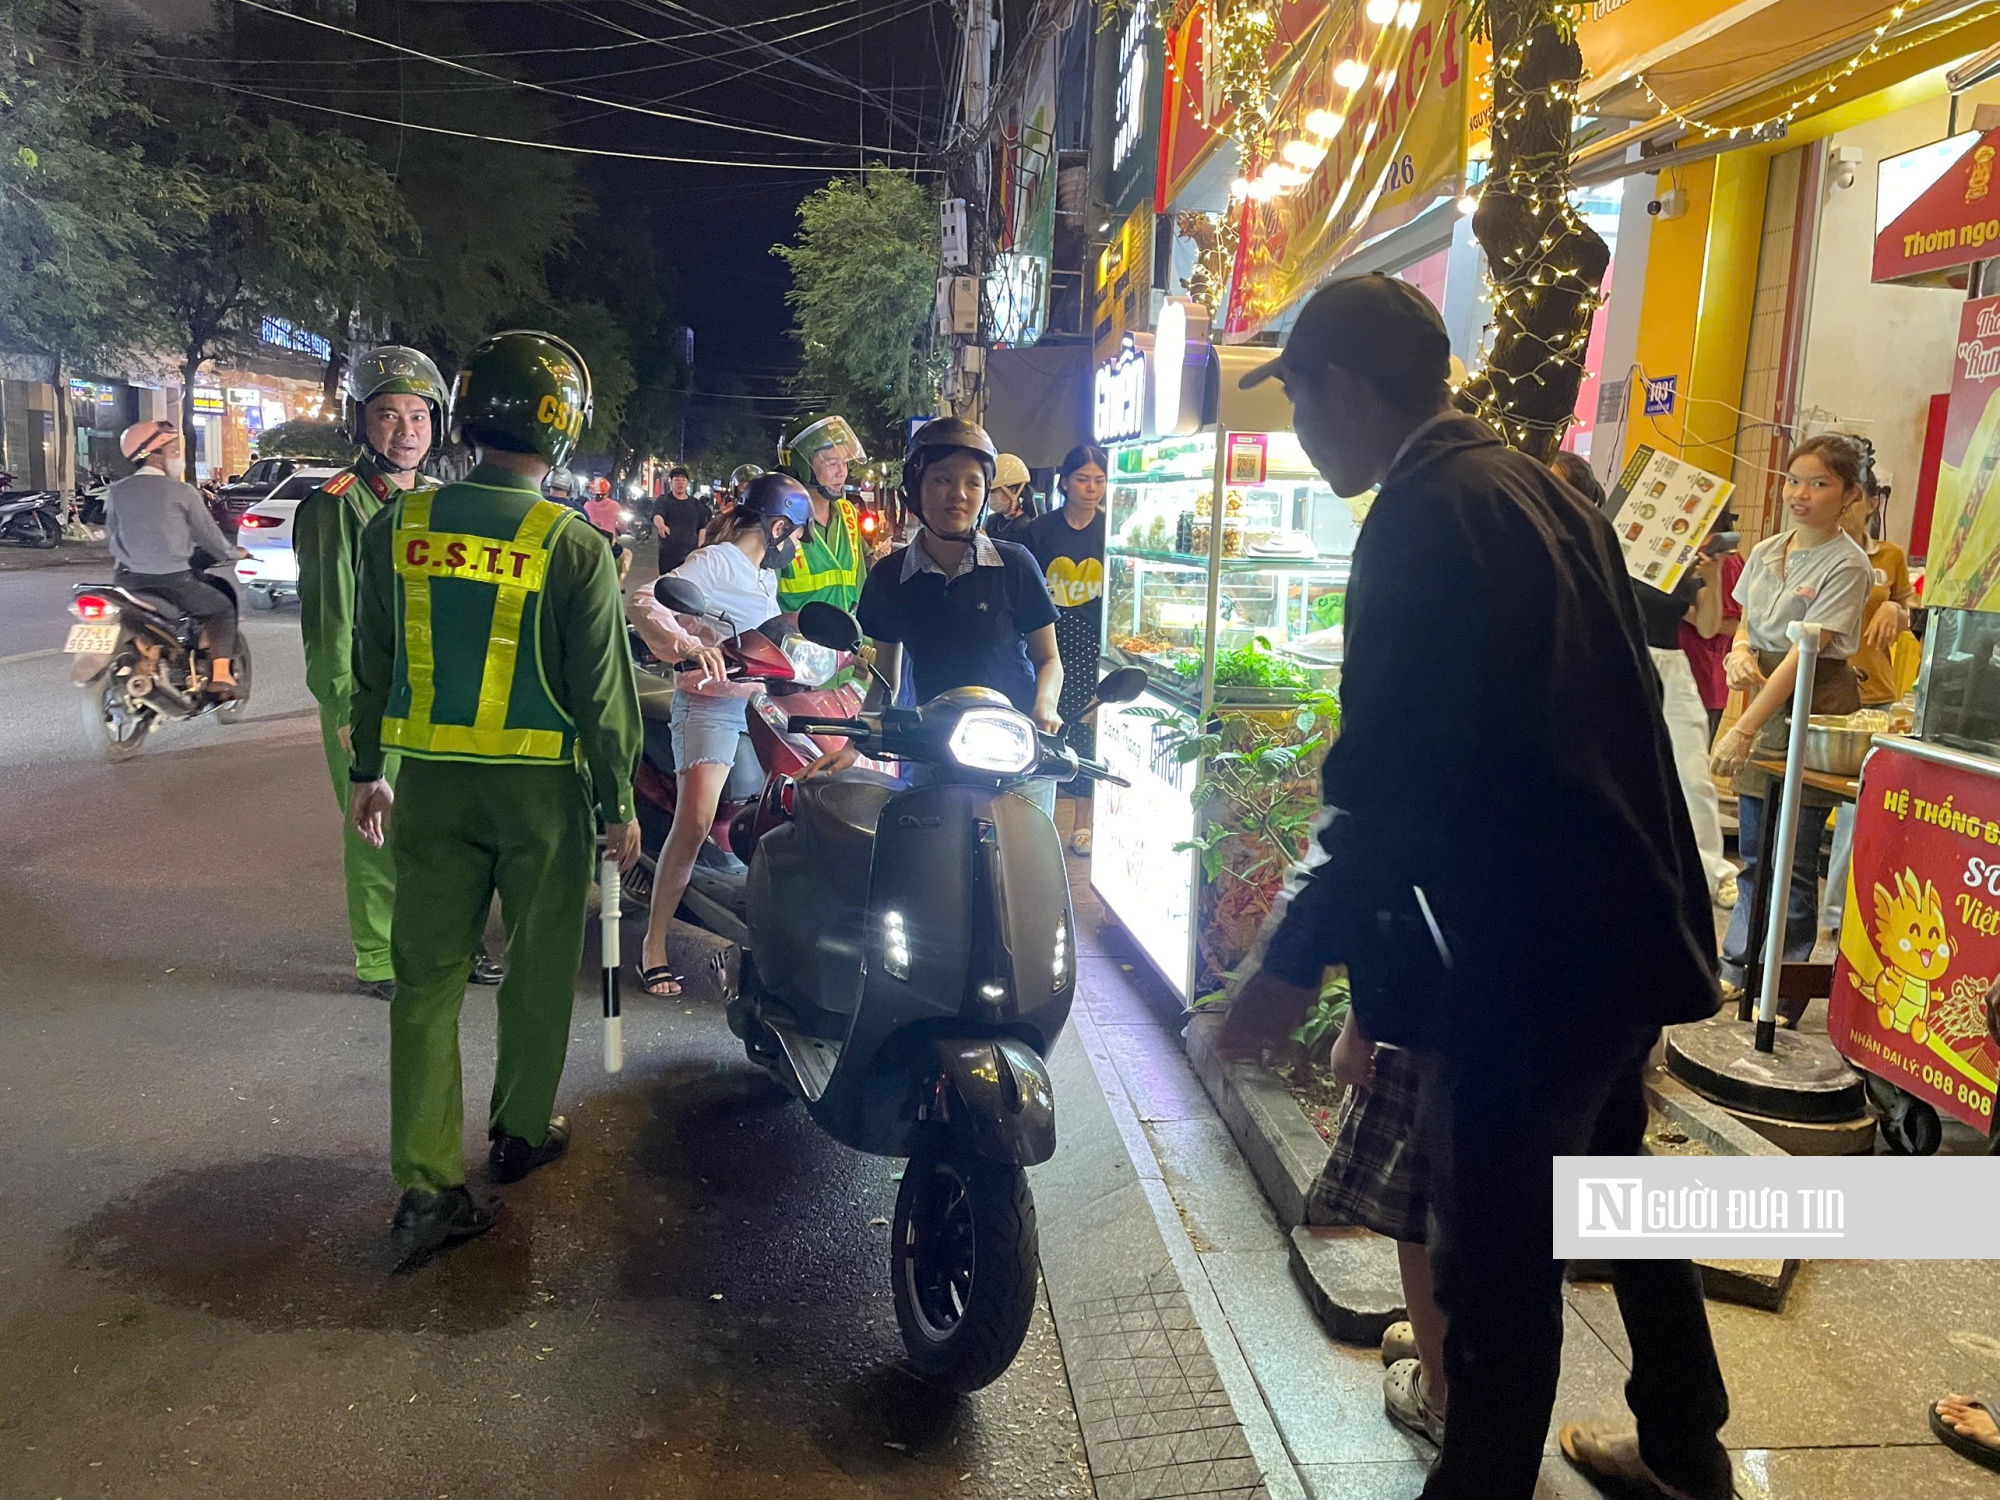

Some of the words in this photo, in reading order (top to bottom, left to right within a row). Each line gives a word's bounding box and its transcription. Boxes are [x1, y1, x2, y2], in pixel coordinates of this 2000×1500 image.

[1959, 219, 2000, 248] ngo
[406, 539, 531, 578] C.S.T.T
[1884, 788, 1910, 820] HỆ
[1914, 794, 1981, 839] THỐNG
[1984, 821, 2000, 846] B
[1922, 1064, 1954, 1096] 088
[1957, 1083, 1991, 1117] 808
